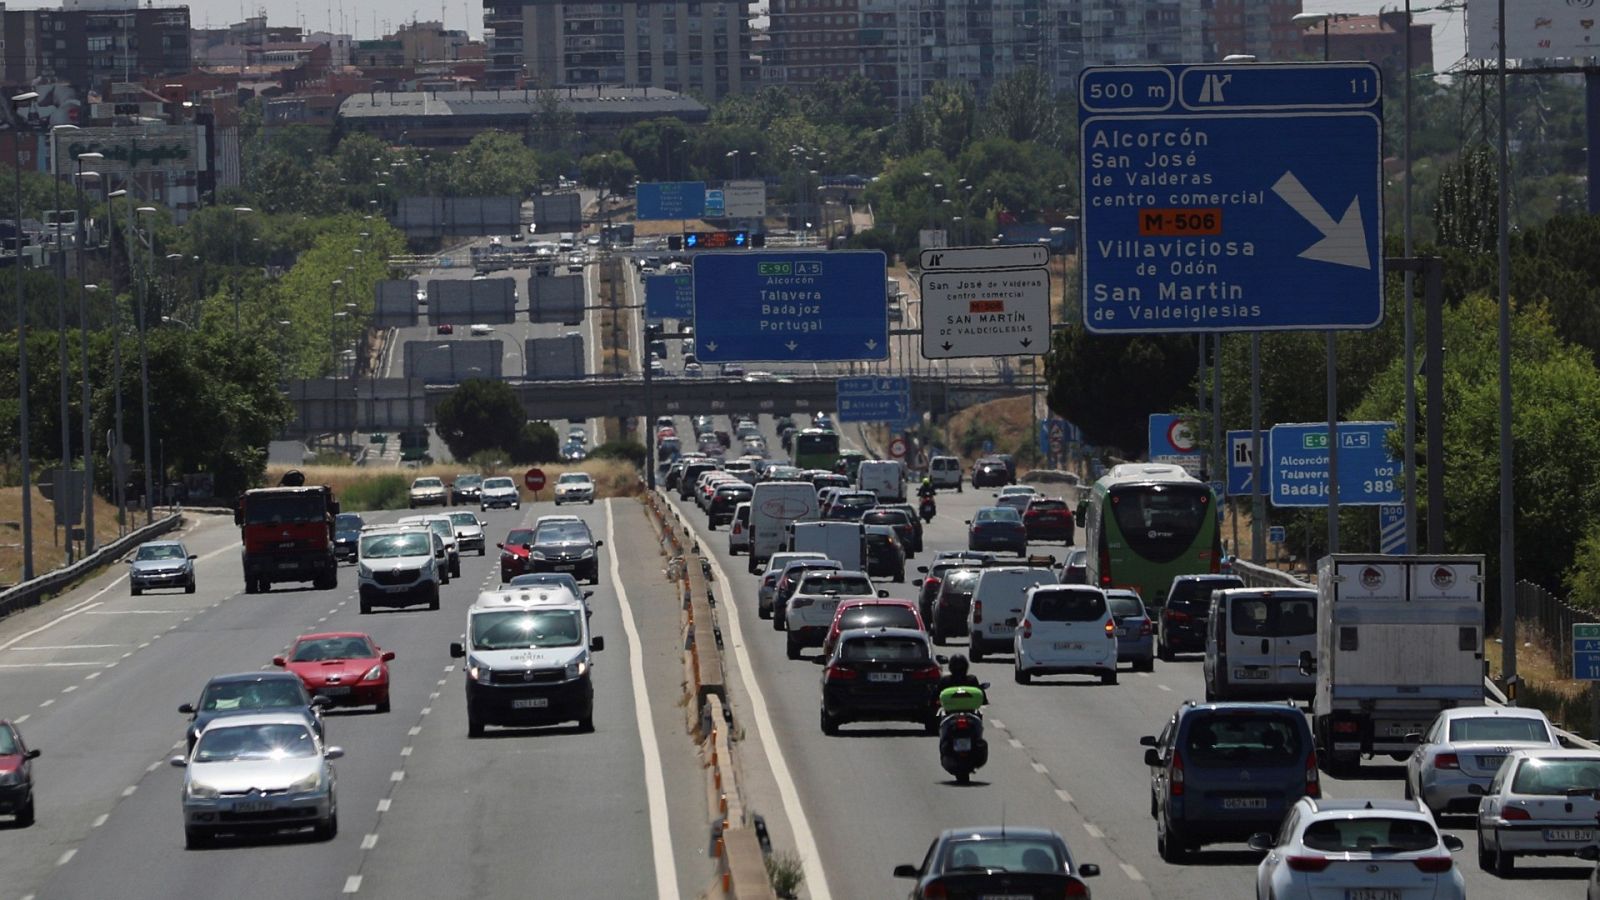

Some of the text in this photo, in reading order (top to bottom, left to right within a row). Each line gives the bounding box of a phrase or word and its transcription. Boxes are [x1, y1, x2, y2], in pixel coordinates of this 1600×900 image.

[1091, 83, 1164, 98] 500 m
[1351, 79, 1367, 93] 11
[1092, 128, 1208, 148] Alcorcón
[1091, 151, 1197, 168] San José
[1091, 171, 1213, 187] de Valderas
[1092, 191, 1264, 206] centro comercial
[1145, 213, 1215, 231] M-506
[1098, 239, 1255, 258] Villaviciosa
[761, 263, 820, 273] E-90 A-5
[1136, 260, 1217, 276] de Odón
[767, 275, 814, 285] Alcorcón
[929, 281, 949, 290] San
[1002, 280, 1042, 288] Valderas
[760, 290, 822, 301] Talavera
[946, 291, 1024, 300] centro comercial
[1094, 284, 1141, 301] San
[761, 303, 820, 317] Badajoz
[1094, 304, 1261, 322] de Valdeiglesias
[946, 311, 1026, 325] SAN MARTÍN
[760, 320, 823, 333] Portugal
[1305, 435, 1368, 447] E-9 A-5
[1280, 467, 1394, 480] Talavera 102
[1363, 480, 1394, 493] 389
[1382, 507, 1404, 516] 300
